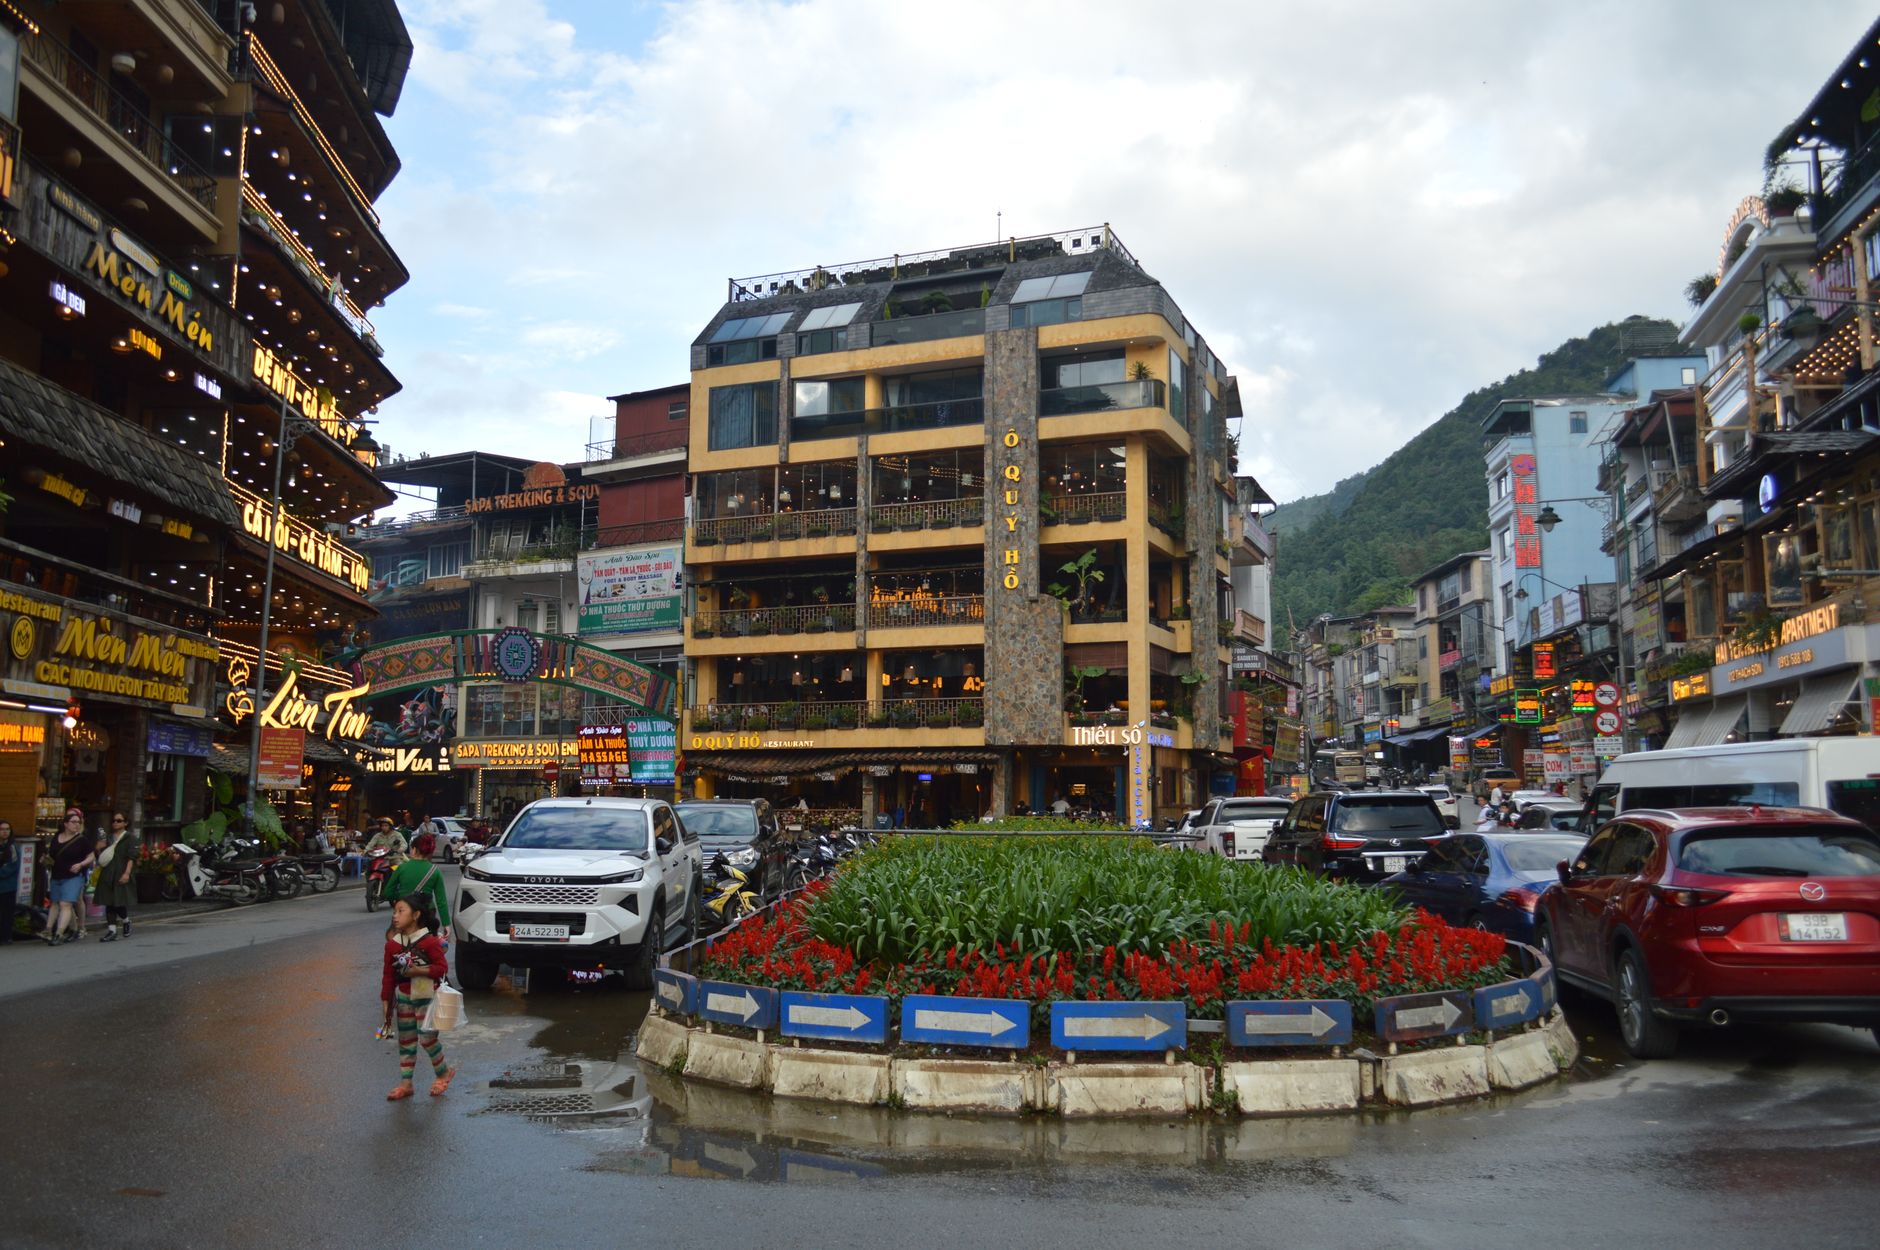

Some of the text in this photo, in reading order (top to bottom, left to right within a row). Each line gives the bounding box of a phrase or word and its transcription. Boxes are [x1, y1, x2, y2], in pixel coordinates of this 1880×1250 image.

[169, 274, 190, 297] Drink
[87, 242, 213, 352] Mèn Mén
[464, 498, 492, 514] SAPA
[495, 489, 552, 510] TREKKING
[556, 488, 564, 503] &
[1004, 428, 1020, 590] Ô QUÝ HỒ
[300, 531, 315, 564] CÁ
[1715, 642, 1728, 666] HAI
[1780, 603, 1838, 645] APARTMENT
[56, 616, 186, 678] Mèn Mén
[38, 658, 188, 704] CÁC MÓN NGON TÂY BẮC
[260, 670, 320, 733] Liên
[637, 718, 652, 732] NHÀ
[1072, 723, 1115, 745] Thiểu
[457, 744, 480, 758] SAPA
[482, 742, 526, 758] TREKKING
[527, 743, 534, 756] &
[604, 736, 627, 749] THUỐC
[692, 734, 702, 749] Ô
[706, 732, 735, 750] QUÝ
[740, 731, 760, 748] HỒ
[580, 751, 628, 763] MASSAGE
[1802, 914, 1828, 927] 99B
[515, 927, 565, 937] 24A-522.99
[1796, 928, 1841, 940] 141.52
